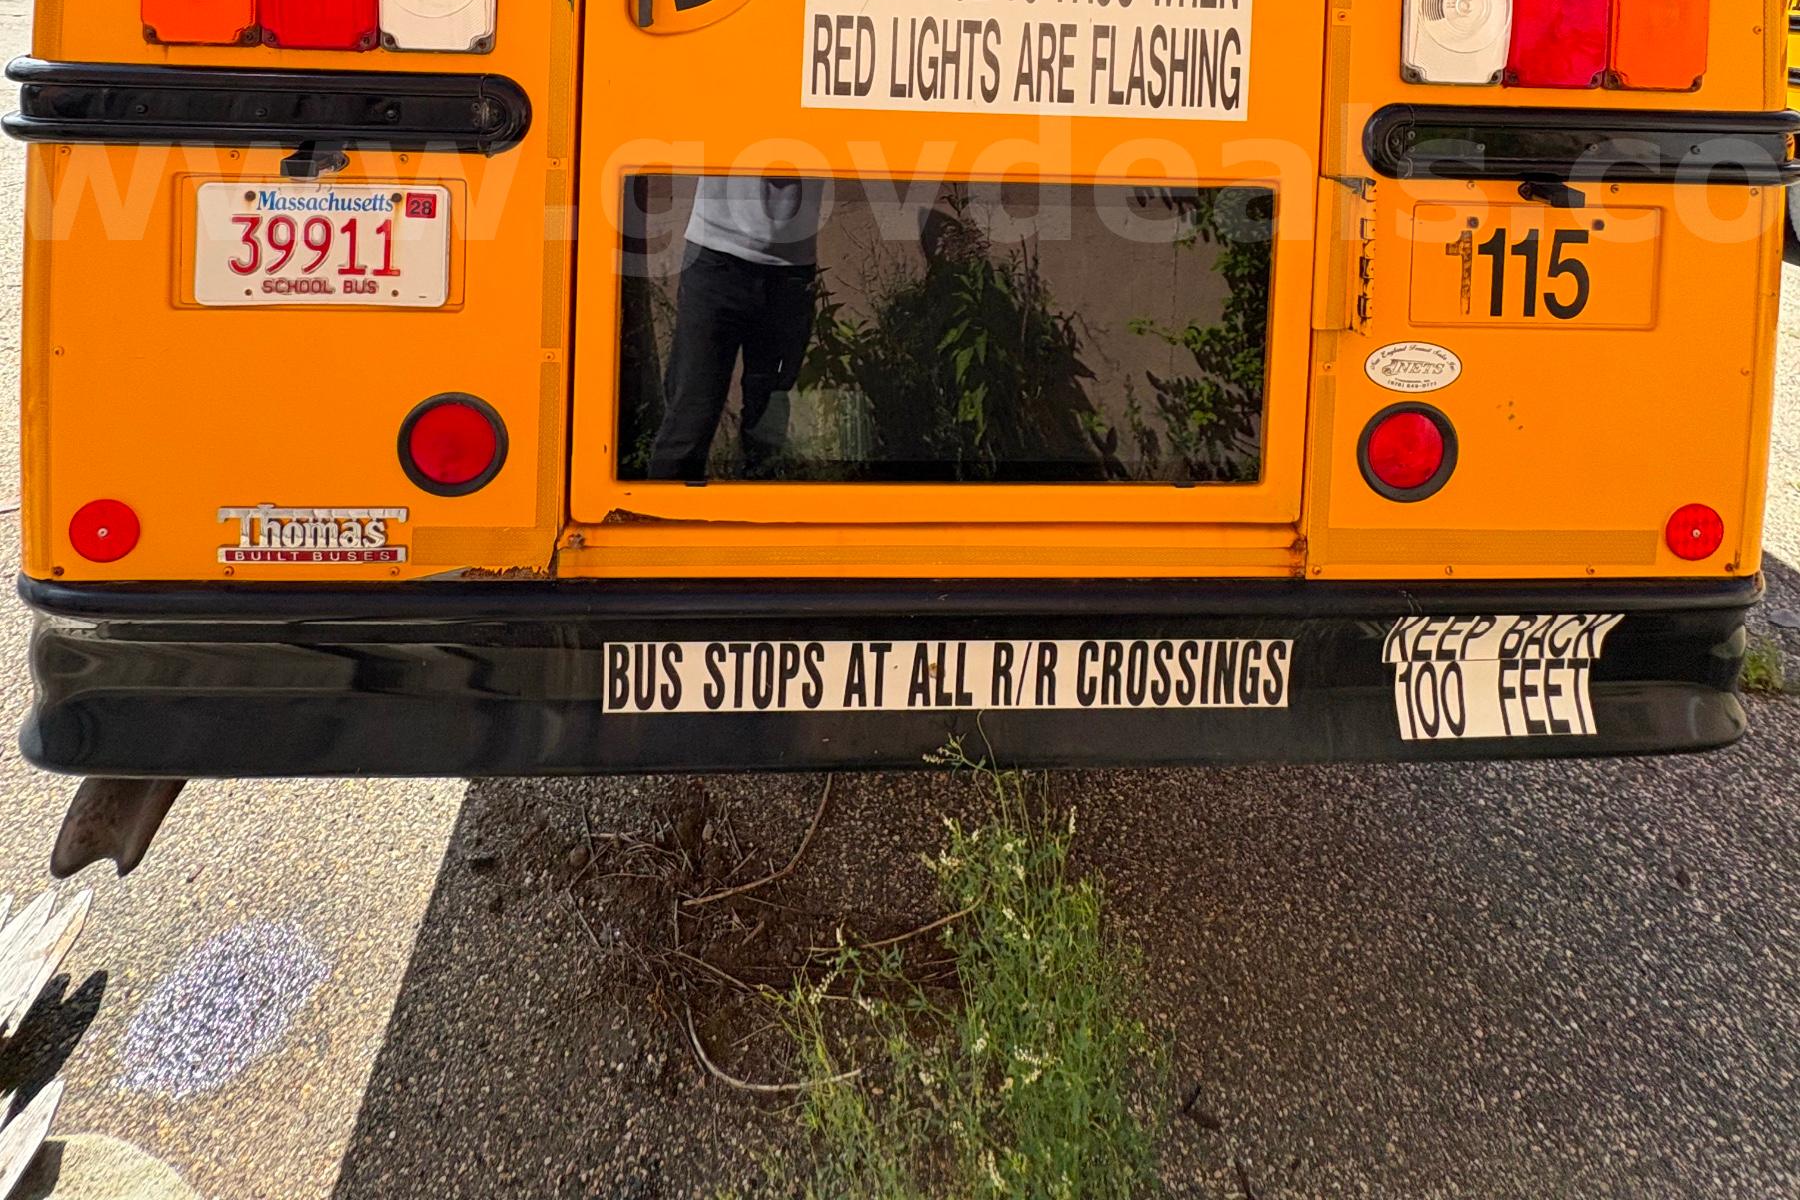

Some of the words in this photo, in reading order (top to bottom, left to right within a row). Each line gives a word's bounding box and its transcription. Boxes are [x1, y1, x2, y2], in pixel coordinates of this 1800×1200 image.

[811, 14, 876, 97] RED
[889, 16, 1001, 103] LIGHTS
[1013, 22, 1078, 104] ARE
[1090, 24, 1242, 111] FLASHING
[256, 190, 394, 212] Massachusetts
[410, 199, 432, 215] 28
[228, 213, 401, 276] 39911
[261, 278, 336, 294] SCHOOL
[343, 279, 378, 294] BUS
[217, 504, 407, 548] Thomas
[234, 551, 299, 561] BUILT
[312, 552, 391, 561] BUSES
[1384, 615, 1498, 662] KEEP
[1499, 614, 1612, 659] BACK
[607, 643, 684, 710] BUS
[704, 643, 825, 709] STOPS
[843, 642, 893, 708] AT
[908, 642, 973, 708] ALL
[991, 641, 1057, 707] R/R
[1076, 640, 1288, 707] CROSSINGS
[1398, 659, 1466, 739] 100
[1500, 657, 1590, 736] FEET
